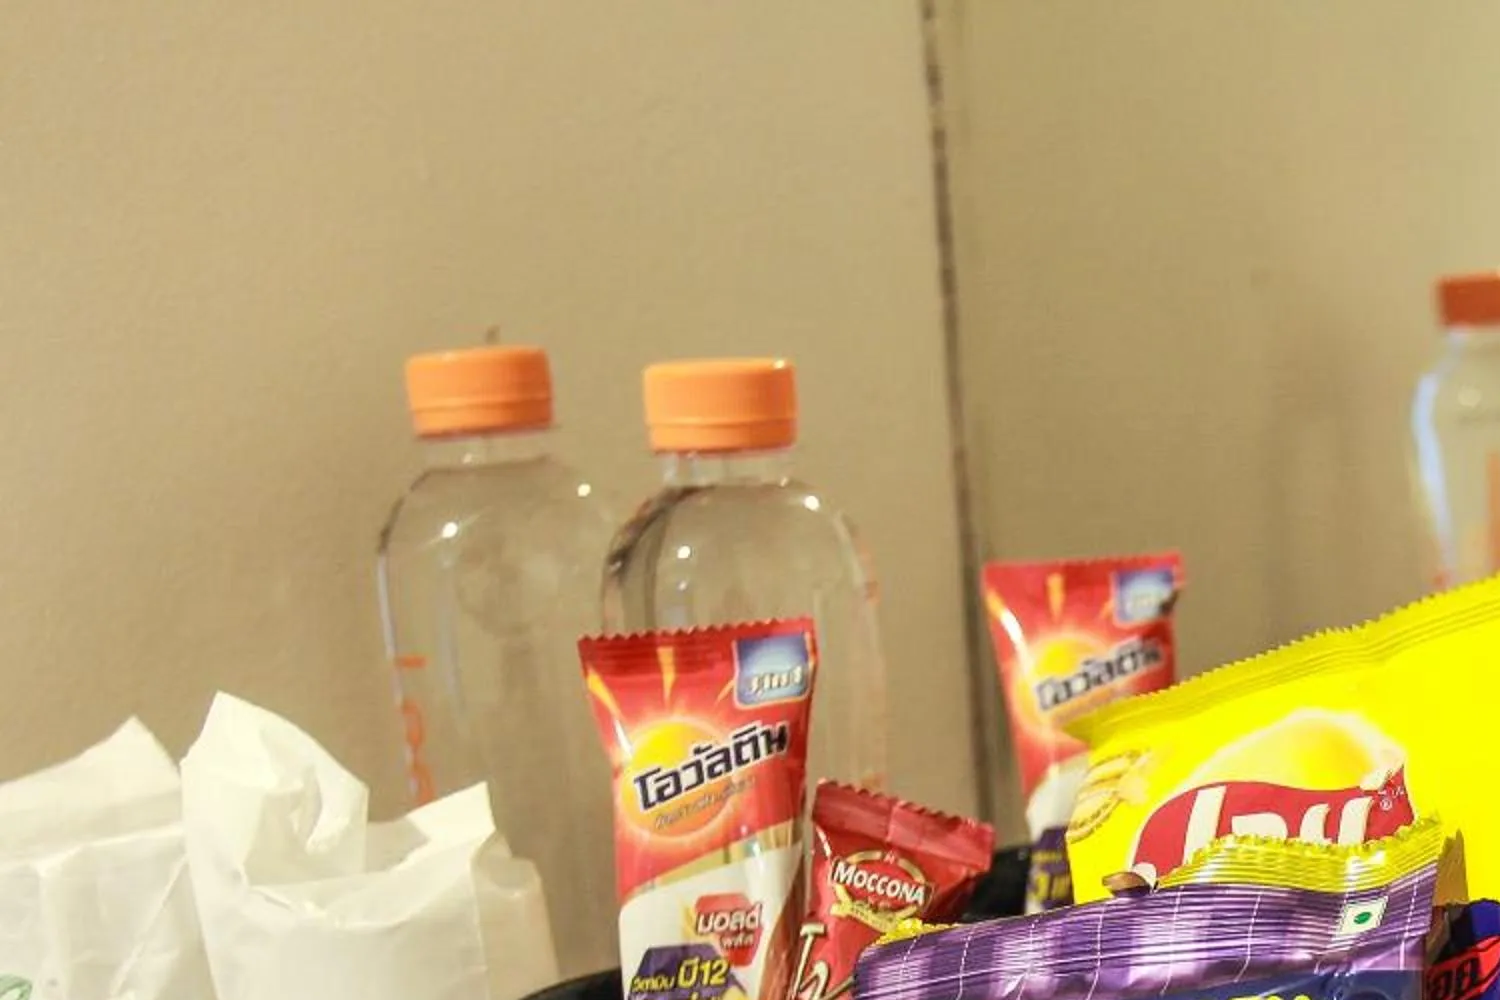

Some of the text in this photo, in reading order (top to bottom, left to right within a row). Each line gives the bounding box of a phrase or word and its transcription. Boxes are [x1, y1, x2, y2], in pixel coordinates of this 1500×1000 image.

[633, 724, 788, 811] โอวัลติน
[833, 860, 925, 906] MOCCONA
